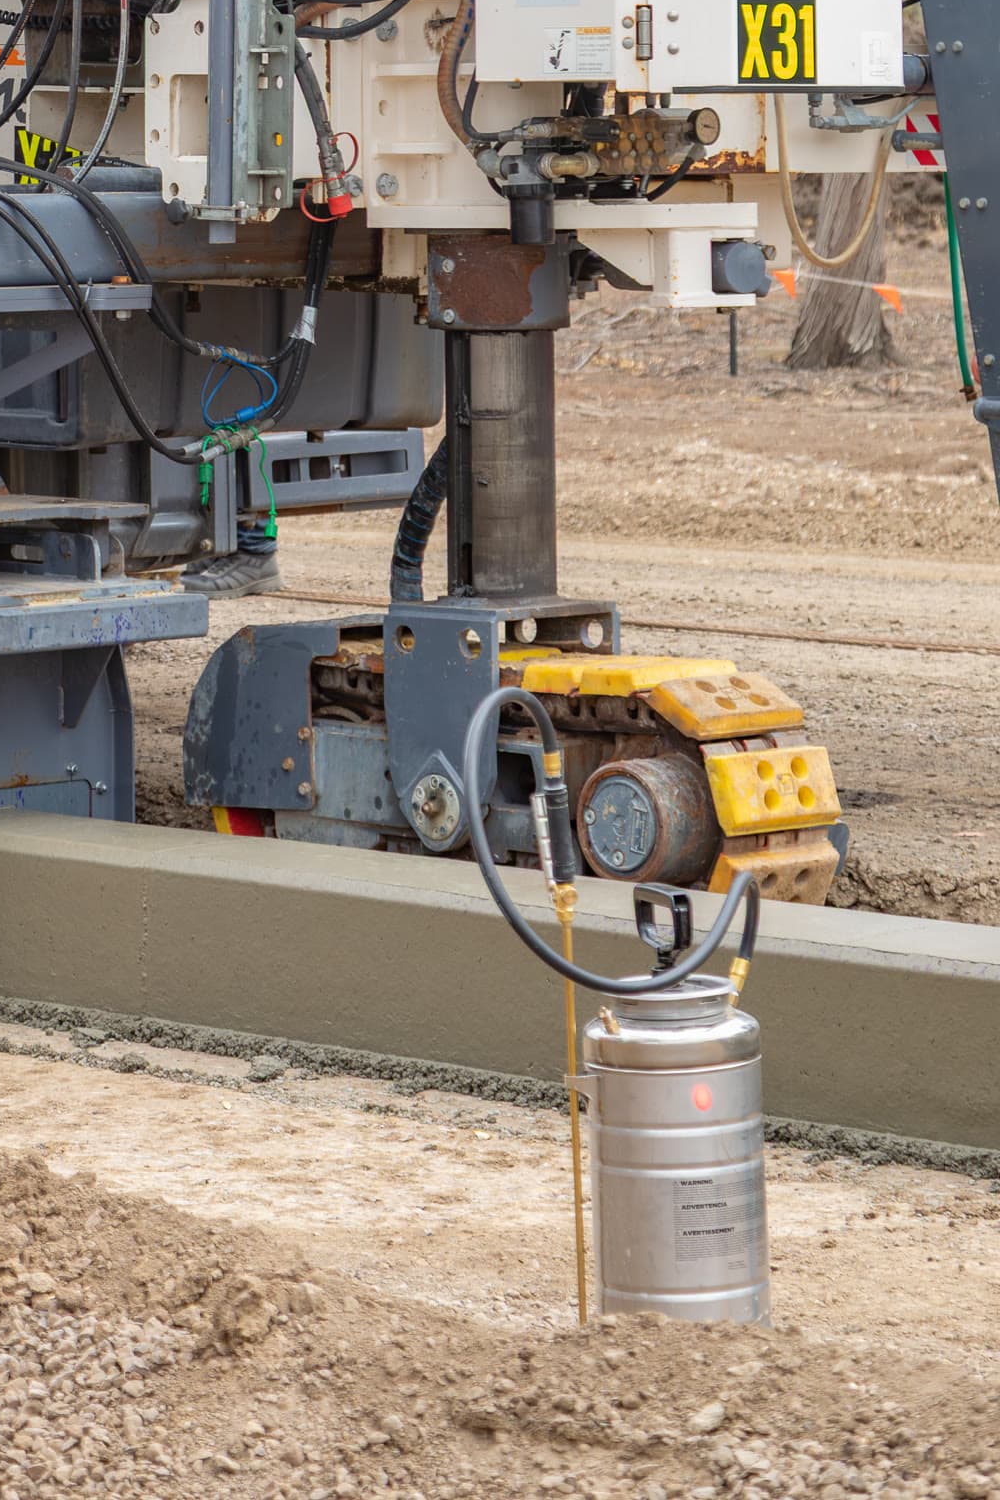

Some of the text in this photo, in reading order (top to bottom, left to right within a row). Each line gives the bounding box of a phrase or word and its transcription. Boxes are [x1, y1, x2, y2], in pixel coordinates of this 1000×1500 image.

[740, 3, 816, 80] X31
[680, 1179, 713, 1187] WARNING
[681, 1202, 727, 1210] ADVERTENCIA
